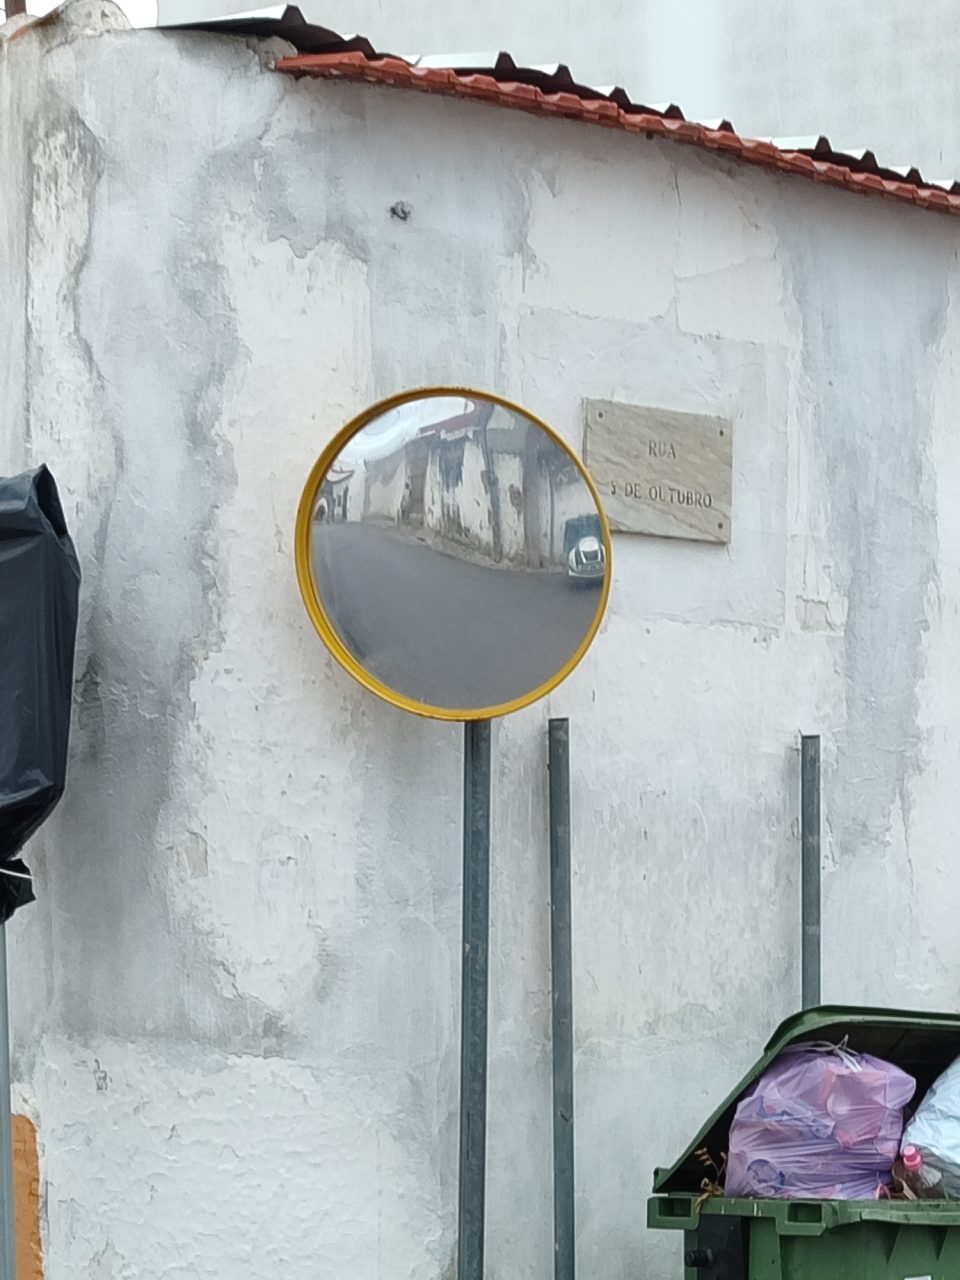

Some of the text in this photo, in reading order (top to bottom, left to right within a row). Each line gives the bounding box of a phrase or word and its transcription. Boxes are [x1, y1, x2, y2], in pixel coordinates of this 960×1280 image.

[648, 439, 677, 459] RUA
[624, 482, 642, 498] DE
[648, 485, 712, 508] OUTUBRO
